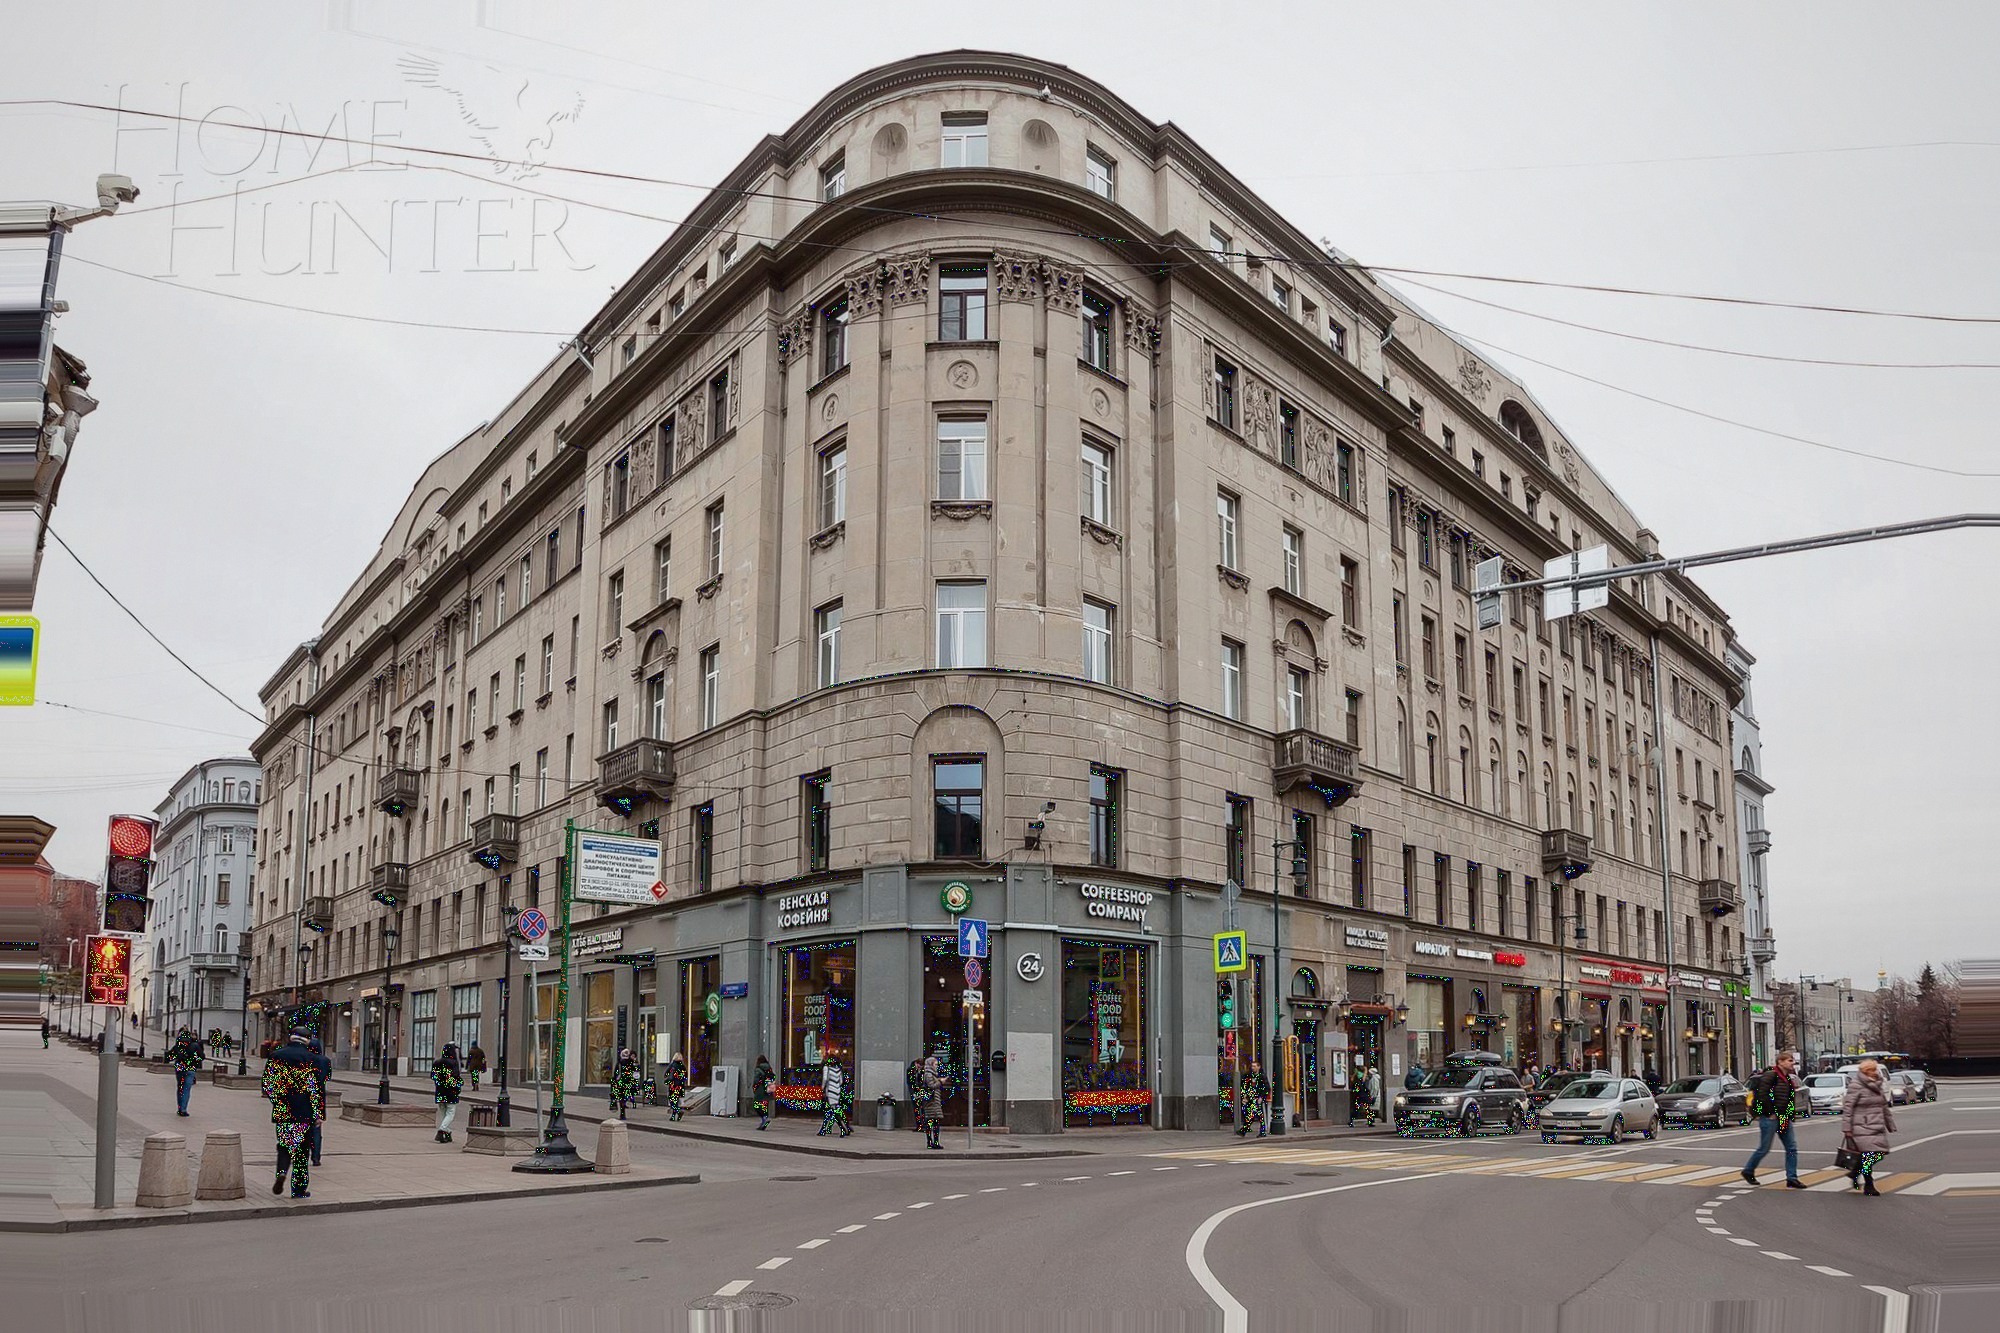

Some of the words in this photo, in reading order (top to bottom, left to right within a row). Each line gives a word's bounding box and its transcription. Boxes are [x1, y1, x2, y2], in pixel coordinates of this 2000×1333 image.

[1081, 883, 1153, 905] COFFEESHOP
[779, 891, 827, 911] ВЕНСКАЯ
[777, 908, 828, 928] КОФЕЙНЯ
[1088, 902, 1147, 922] COMPANY
[1415, 941, 1451, 956] МИРАТОРГ
[1022, 960, 1040, 973] 24
[804, 995, 825, 1004] COFFEE
[1098, 994, 1122, 1003] COFFEE
[804, 1005, 825, 1016] FOOD
[1098, 1004, 1122, 1014] FOOD
[803, 1017, 825, 1025] SWEETS
[1098, 1016, 1122, 1024] SWEETS
